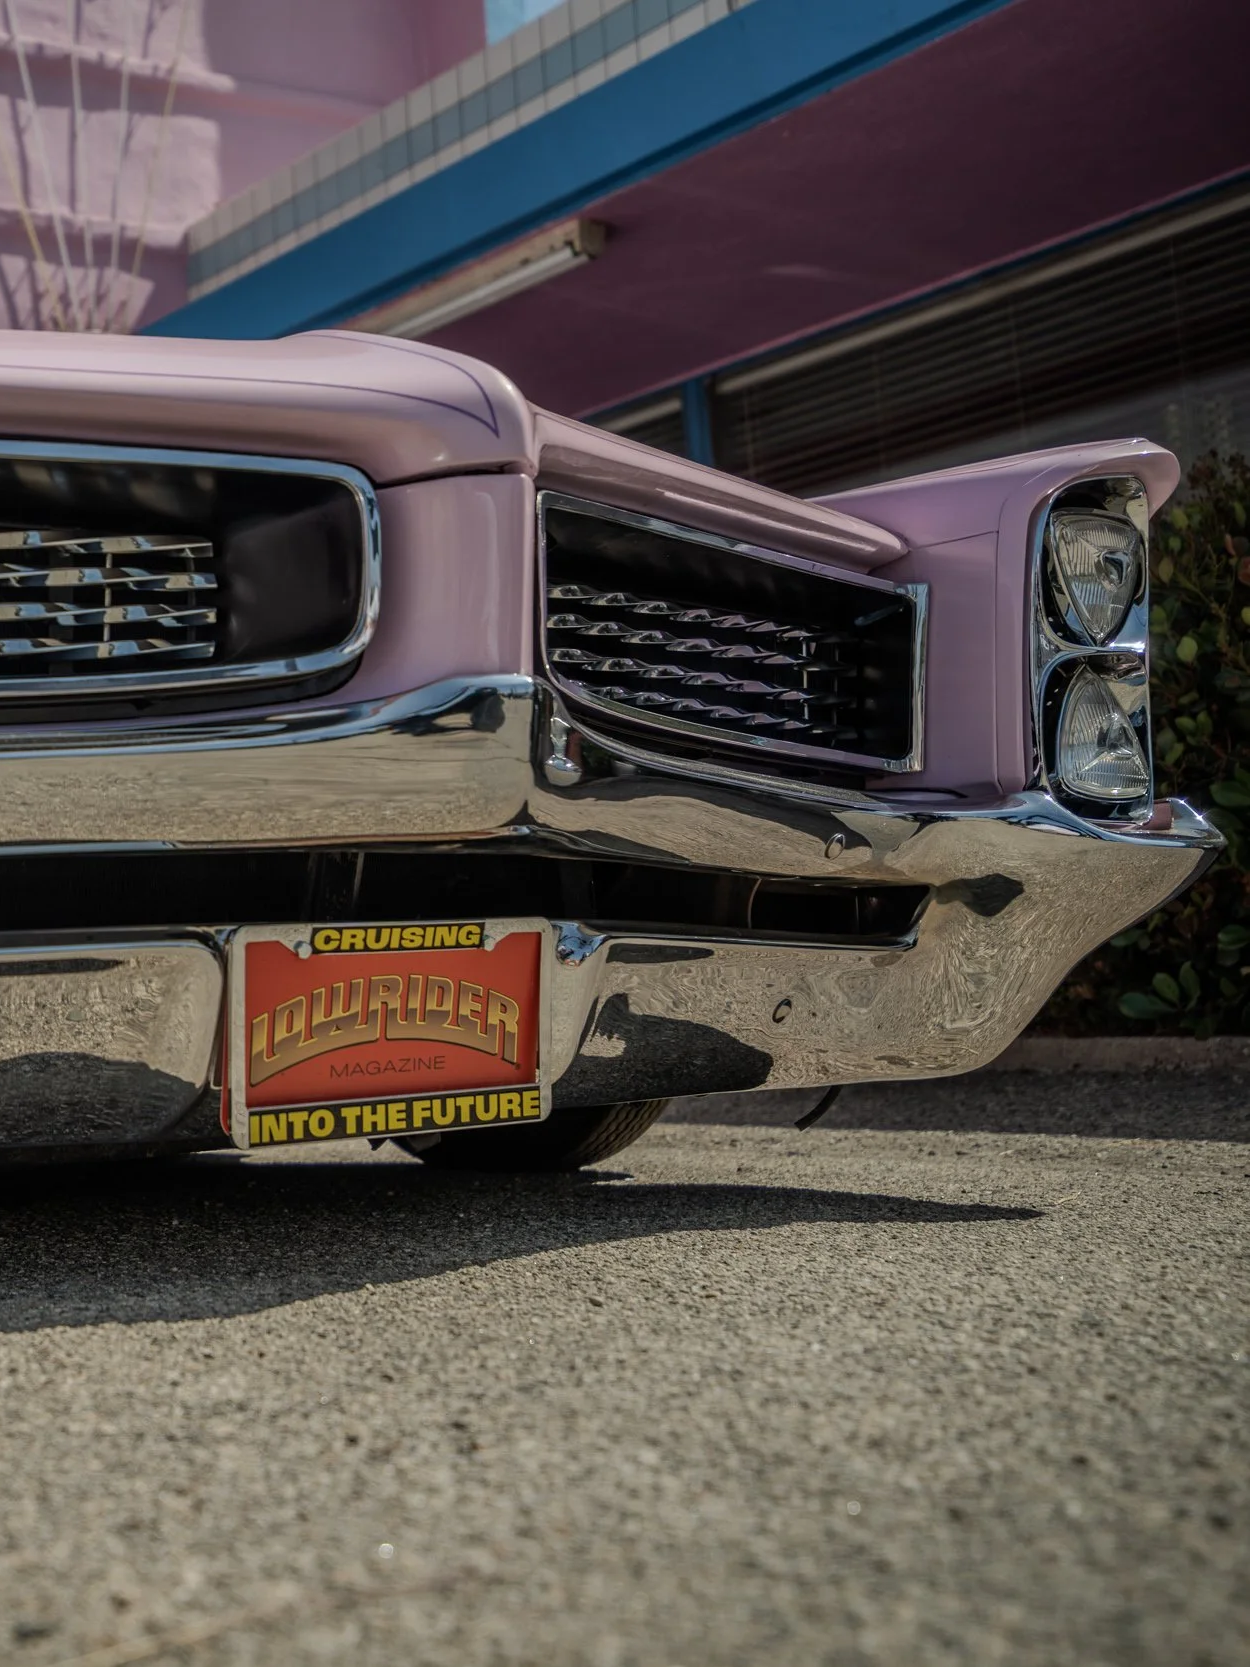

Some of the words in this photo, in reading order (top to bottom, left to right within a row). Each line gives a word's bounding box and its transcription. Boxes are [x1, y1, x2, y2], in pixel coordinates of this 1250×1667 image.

[314, 925, 481, 950] CRUISING
[250, 974, 519, 1087] LOWRIDER
[330, 1056, 446, 1078] MAGAZINE
[250, 1109, 335, 1144] INTO
[341, 1103, 407, 1134] THE
[412, 1091, 540, 1128] FUTURE
